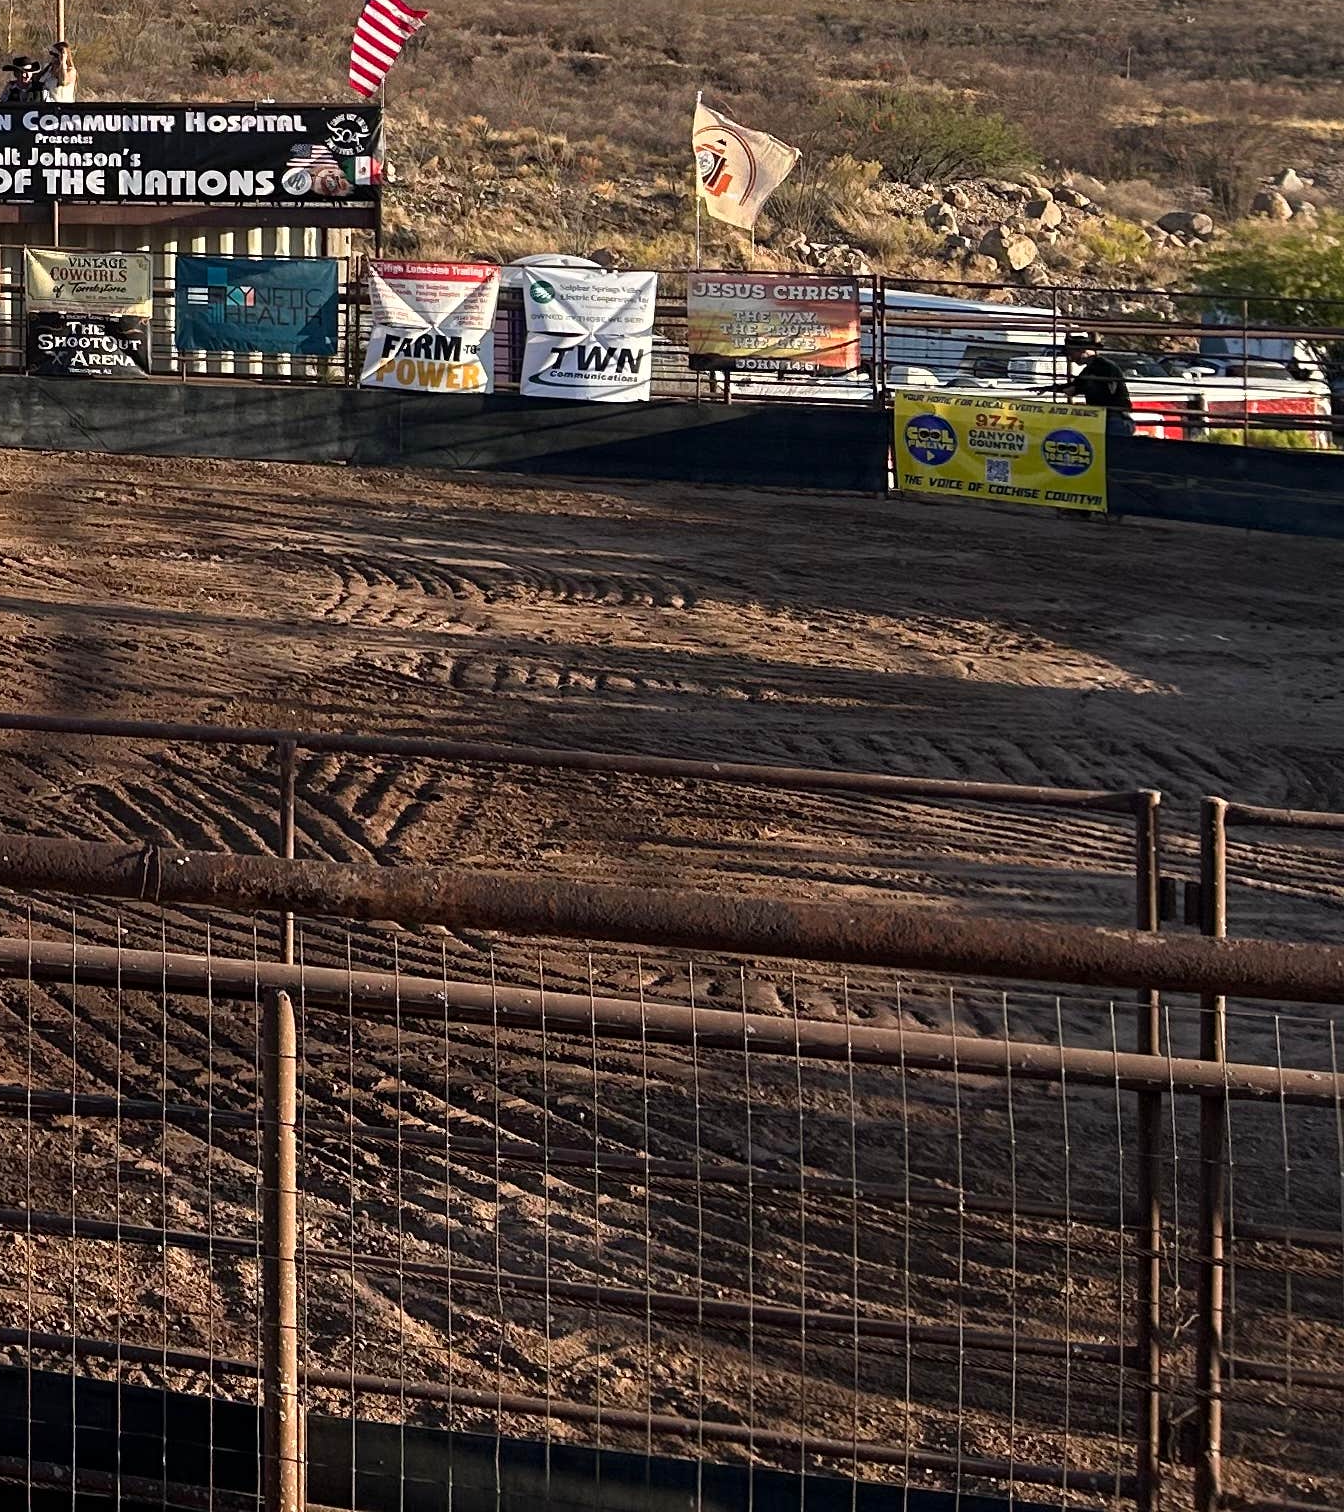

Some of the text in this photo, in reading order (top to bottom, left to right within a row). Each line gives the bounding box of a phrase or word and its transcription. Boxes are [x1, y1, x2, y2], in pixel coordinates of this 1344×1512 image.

[23, 111, 176, 132] COMMUNITY
[185, 111, 307, 133] HOSPITAL
[27, 147, 142, 168] Johnson's
[42, 168, 106, 196] THE
[118, 168, 275, 197] NATIONS
[68, 257, 127, 269] VINTAGE
[50, 266, 128, 283] COWGIRLS
[52, 282, 127, 298] of Tombstone
[226, 286, 322, 309] KYNETIC
[693, 282, 853, 301] JESUS CHRIST
[225, 306, 323, 326] HEALTH
[735, 311, 770, 323] THE
[67, 321, 106, 336] THE
[720, 323, 758, 335] THE
[38, 334, 142, 353] SHOOTOUT
[381, 333, 462, 362] FARM
[732, 337, 769, 349] THE
[71, 350, 136, 367] ARENA
[551, 345, 644, 373] TWN
[735, 358, 780, 370] JOHN
[375, 359, 480, 389] POWER
[549, 370, 638, 383] Communications
[903, 393, 924, 402] YOUR
[955, 397, 972, 406] FOR
[975, 399, 1006, 410] LOCAL
[906, 426, 954, 443] COOL
[968, 429, 1025, 443] CANYON
[969, 438, 1025, 452] COUNTRY
[1045, 441, 1090, 456] COOL
[904, 473, 922, 485] THE
[929, 477, 962, 489] VOICE
[968, 482, 985, 493] OF
[988, 484, 1041, 499] COCHISE
